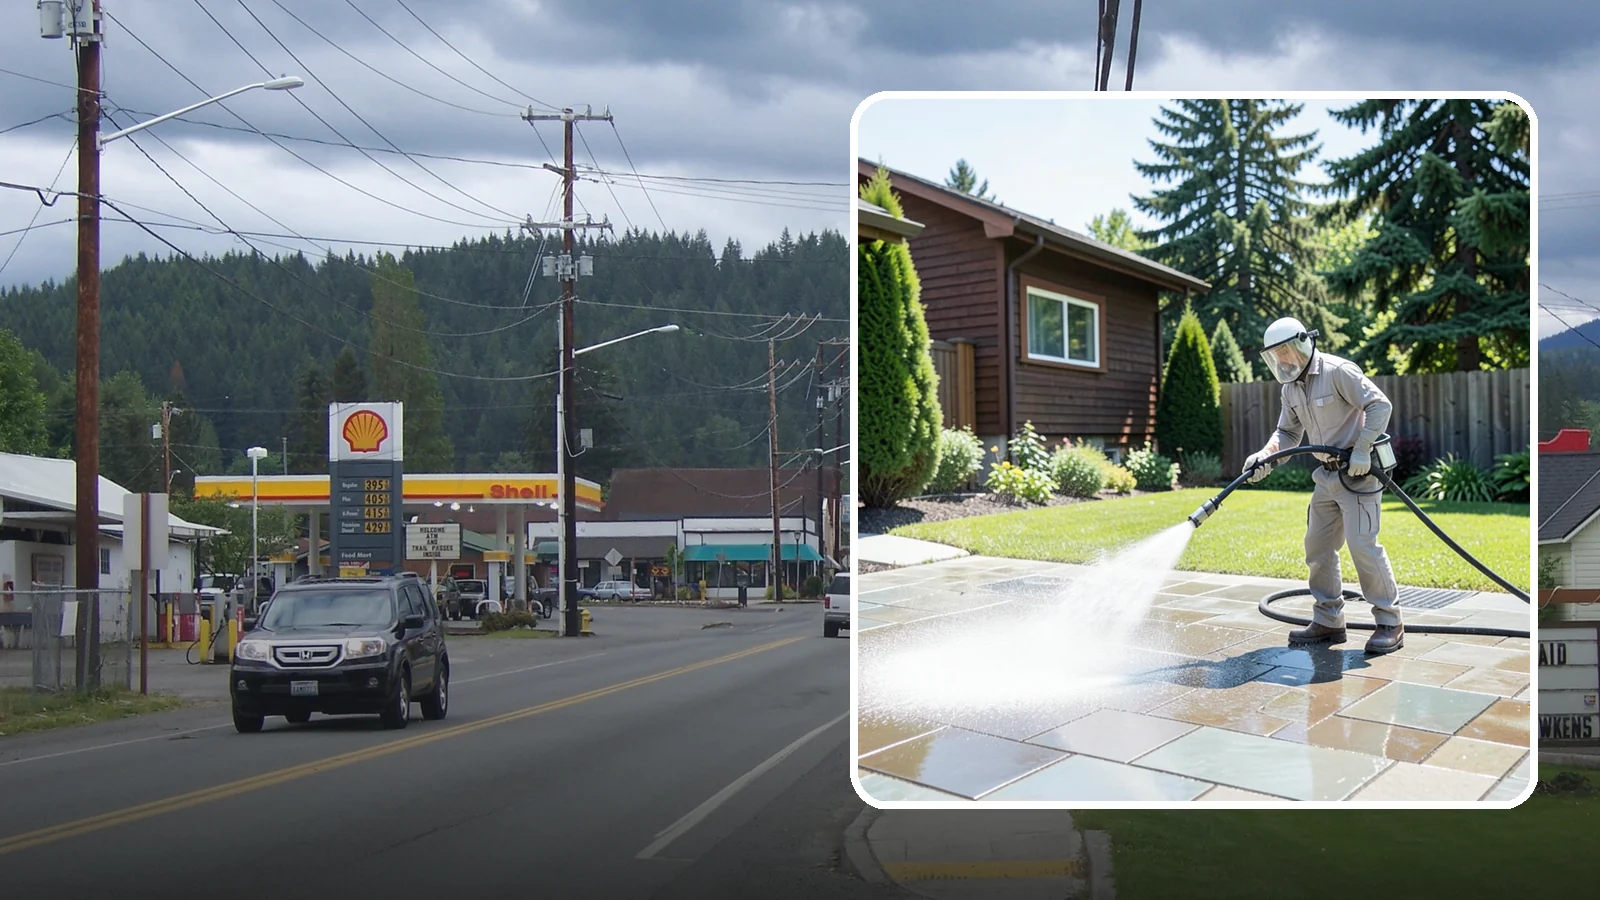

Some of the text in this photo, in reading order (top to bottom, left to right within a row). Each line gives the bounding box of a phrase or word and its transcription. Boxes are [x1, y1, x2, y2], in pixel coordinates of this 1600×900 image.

[365, 480, 383, 490] 395
[490, 484, 547, 499] Shell
[365, 494, 383, 504] 405
[365, 508, 383, 518] 415
[365, 522, 383, 532] 429
